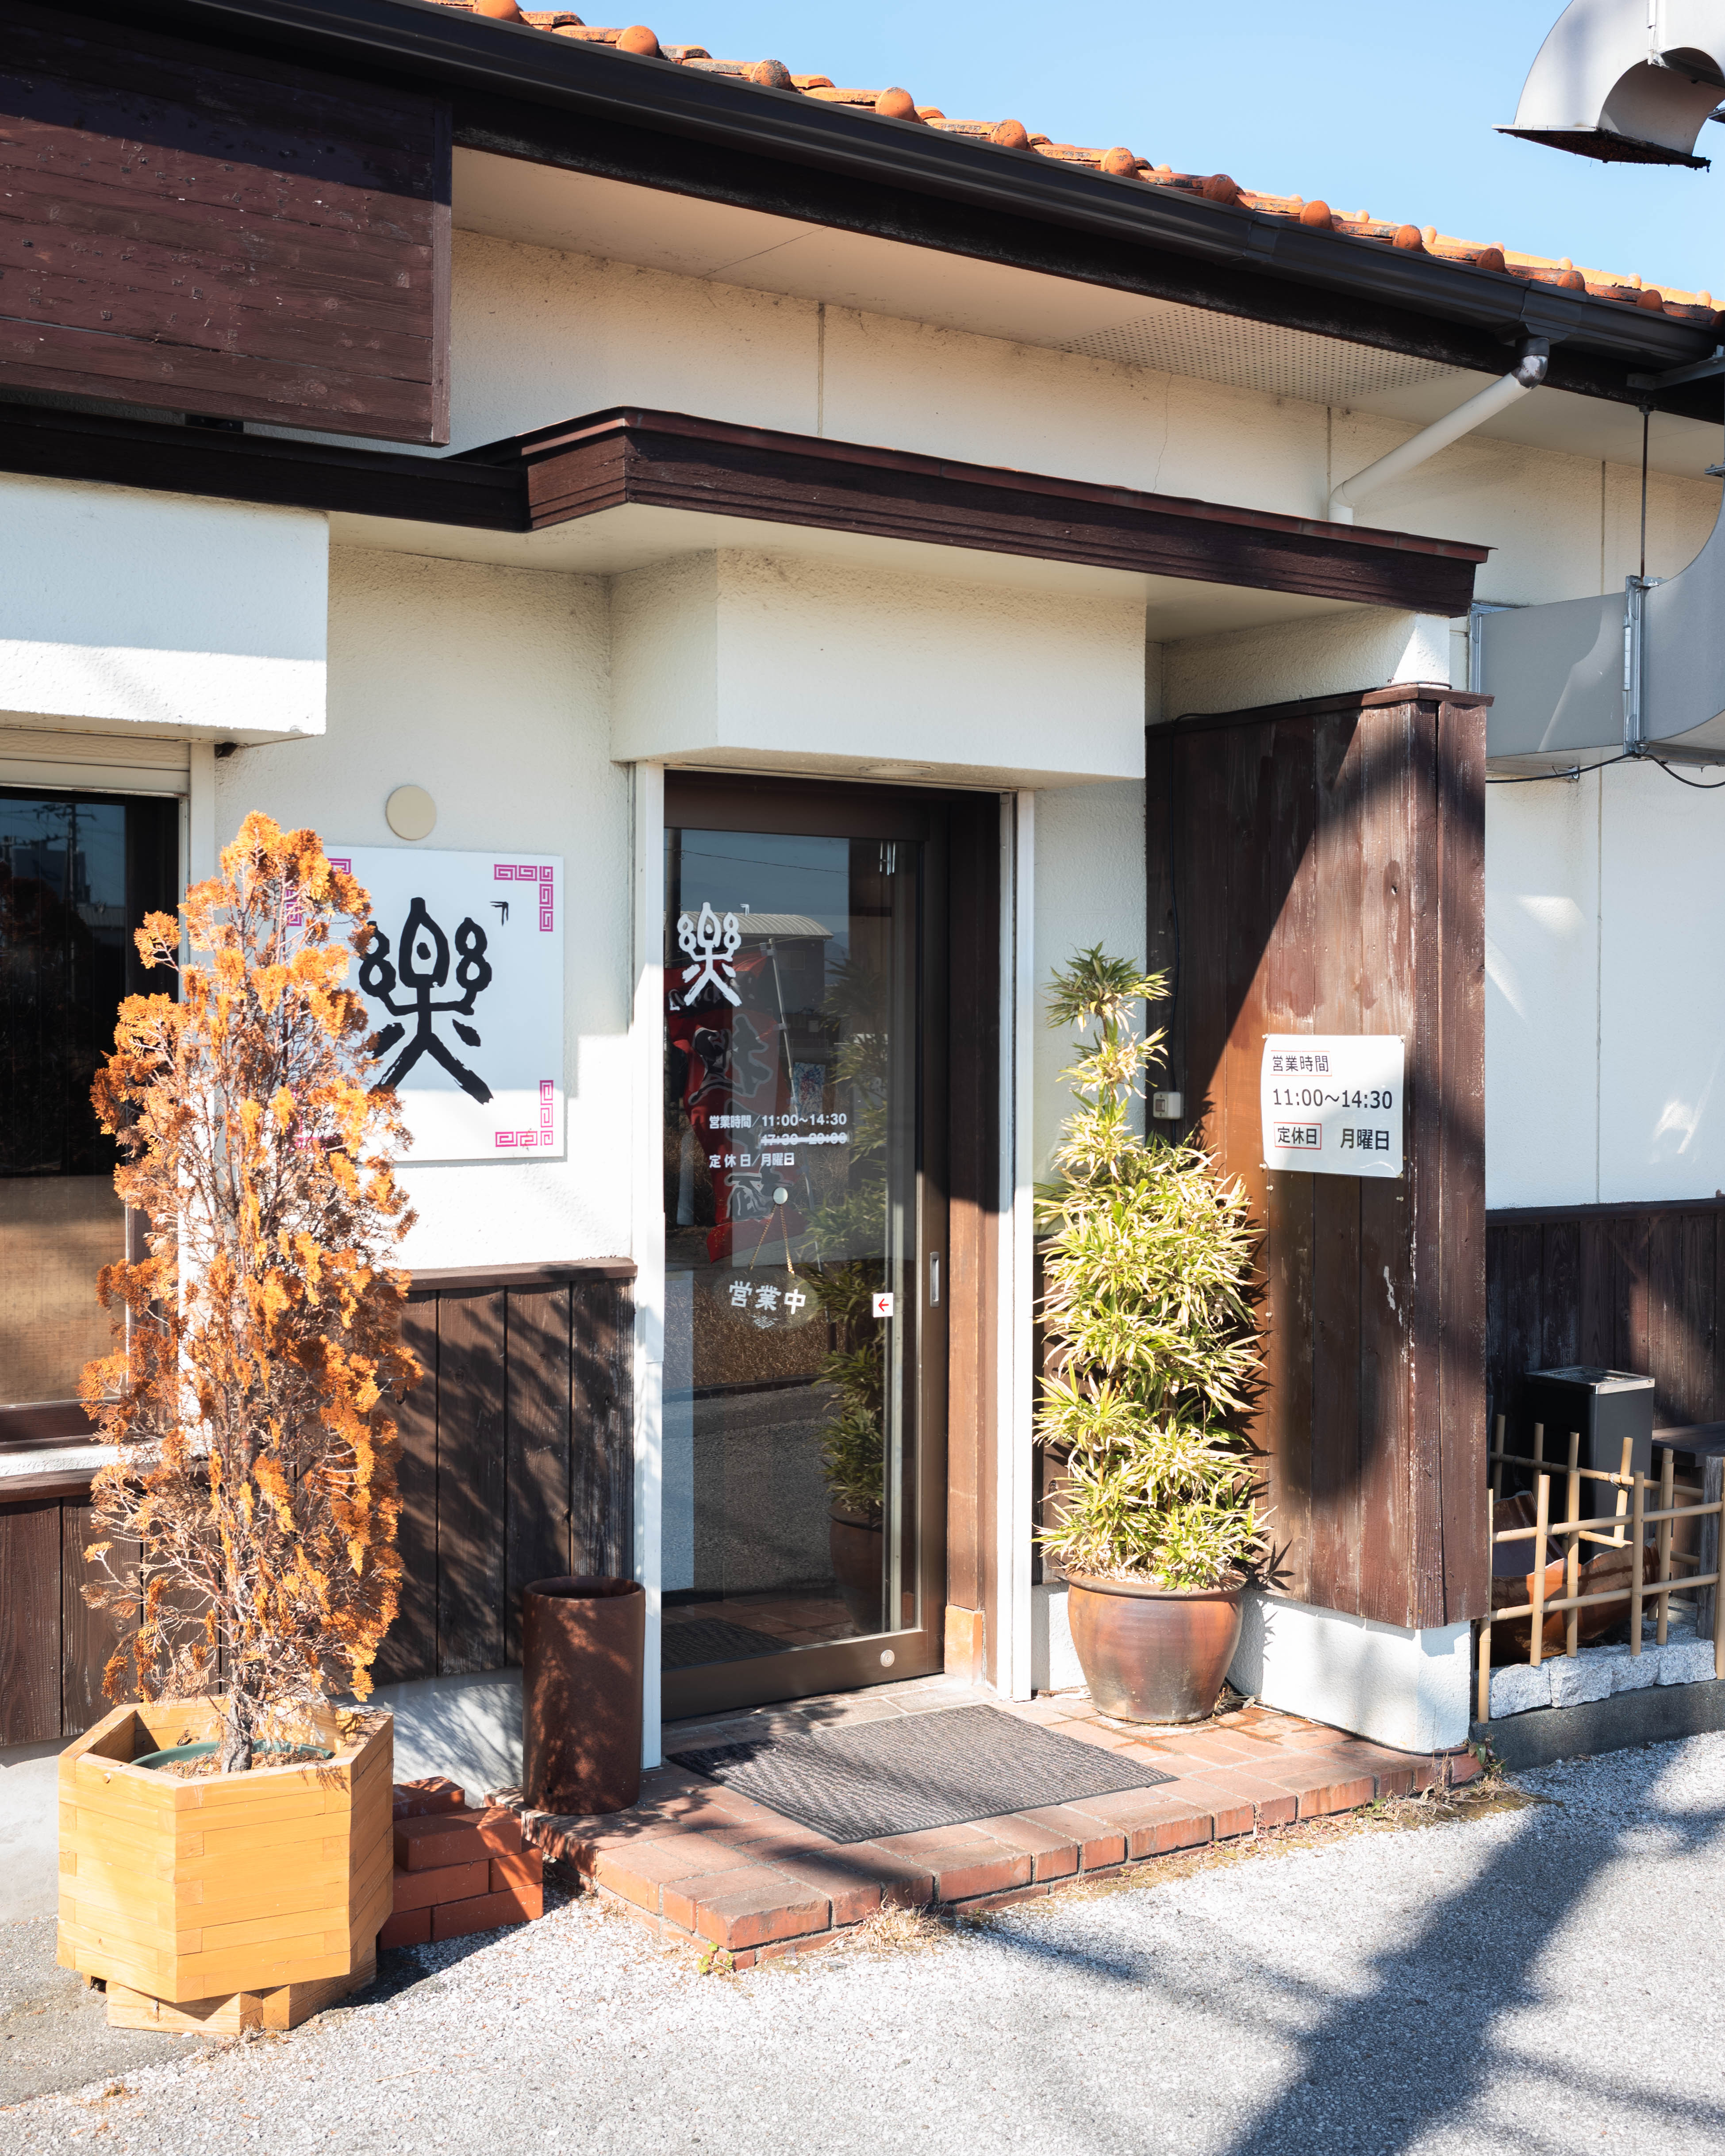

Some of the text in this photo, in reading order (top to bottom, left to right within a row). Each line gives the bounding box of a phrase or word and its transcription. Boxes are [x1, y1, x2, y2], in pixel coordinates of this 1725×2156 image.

[1272, 1055, 1329, 1072] 営業時間
[1273, 1089, 1392, 1109] 11:00～14:30
[1277, 1127, 1389, 1151] 定休日 月曜日
[729, 1281, 806, 1315] 営業中
